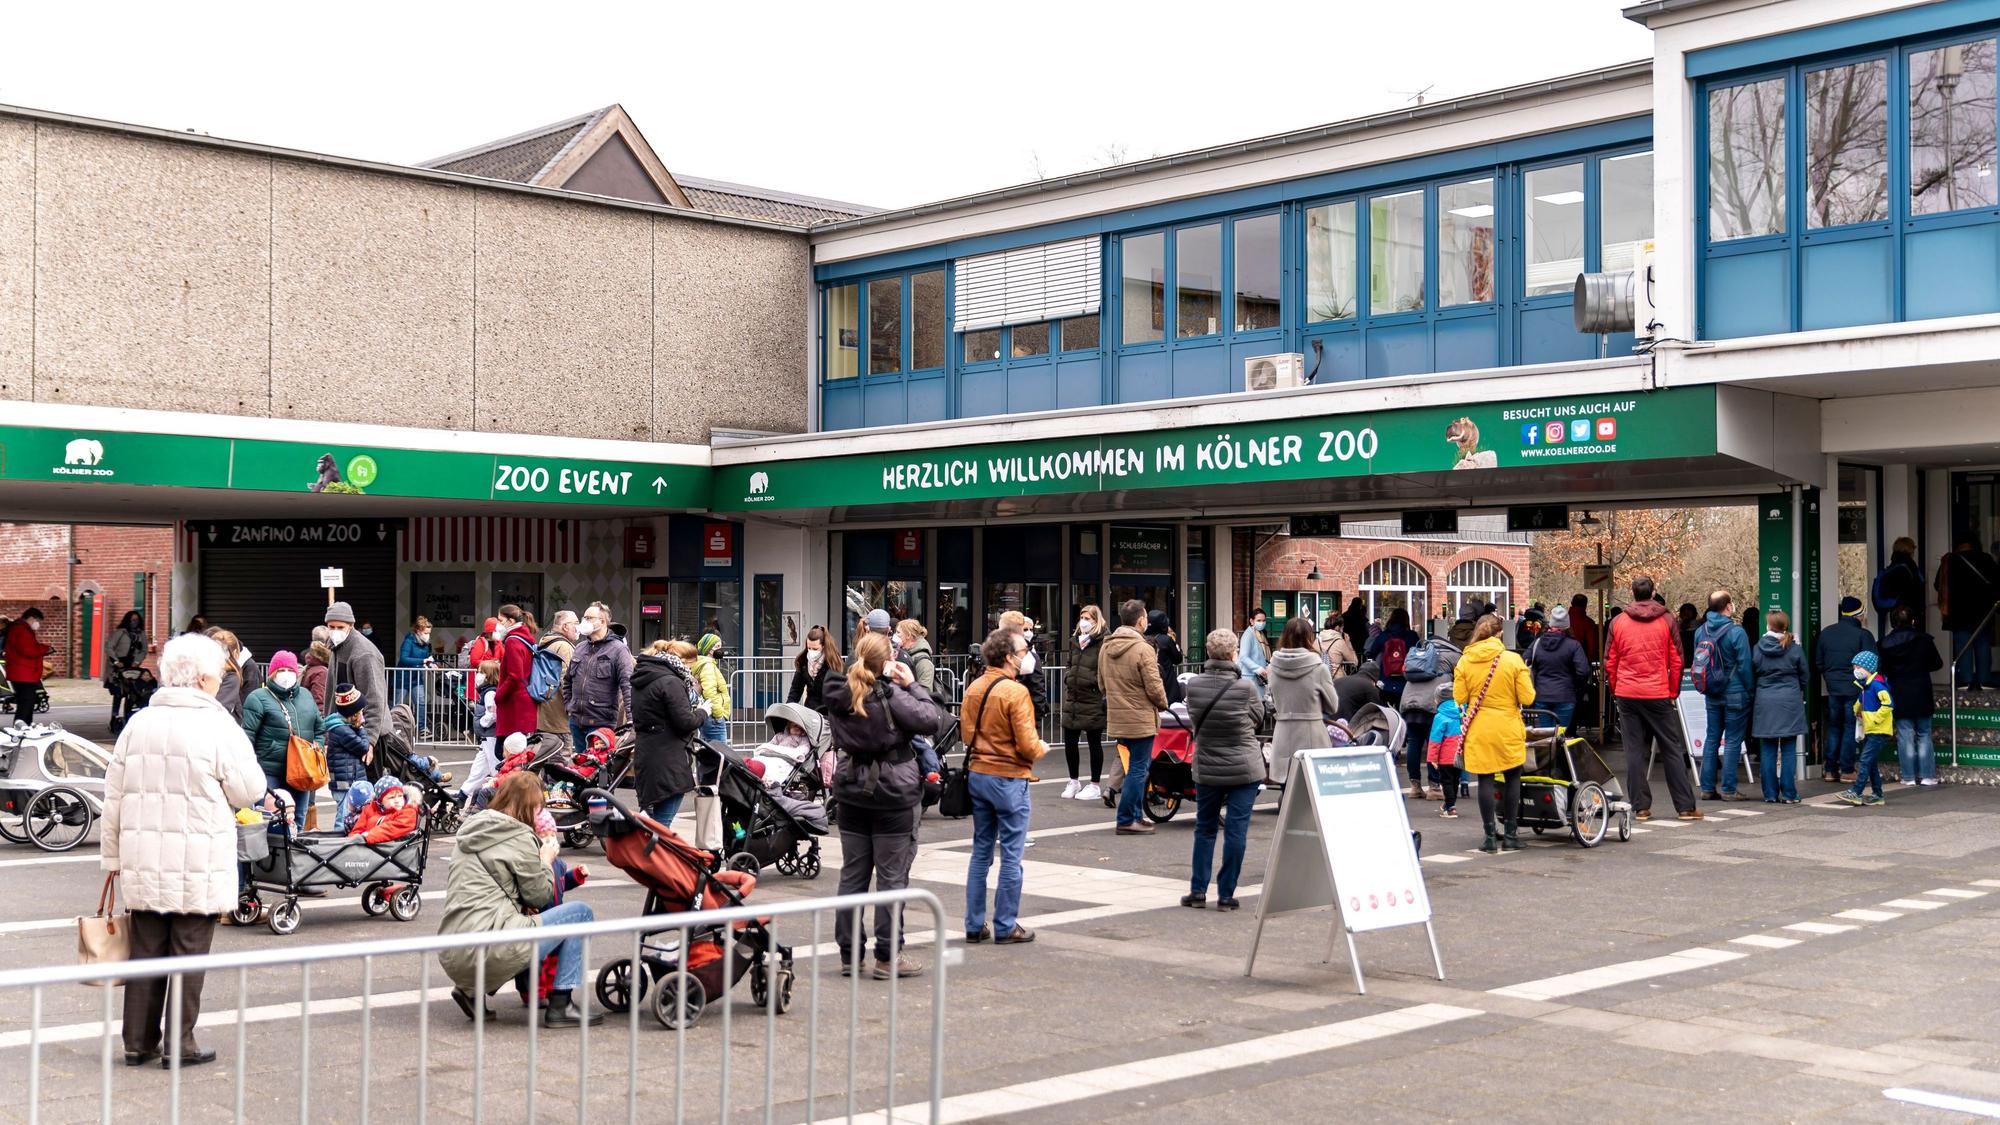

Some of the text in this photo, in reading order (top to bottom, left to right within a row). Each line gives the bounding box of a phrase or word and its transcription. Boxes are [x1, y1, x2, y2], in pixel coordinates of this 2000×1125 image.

[1503, 400, 1636, 420] BESUCHT UNS AUCH AUF
[882, 427, 1379, 490] HERZLICH WILLKOMMEN IM KÖLNER ZOO
[1520, 444, 1617, 458] WWW.KOELNERZOO.DE
[53, 466, 114, 476] KÖLNER ZOO
[494, 465, 633, 495] ZOO EVENT
[231, 523, 362, 543] ZANFINO AM ZOO
[1317, 763, 1348, 776] Wichtige
